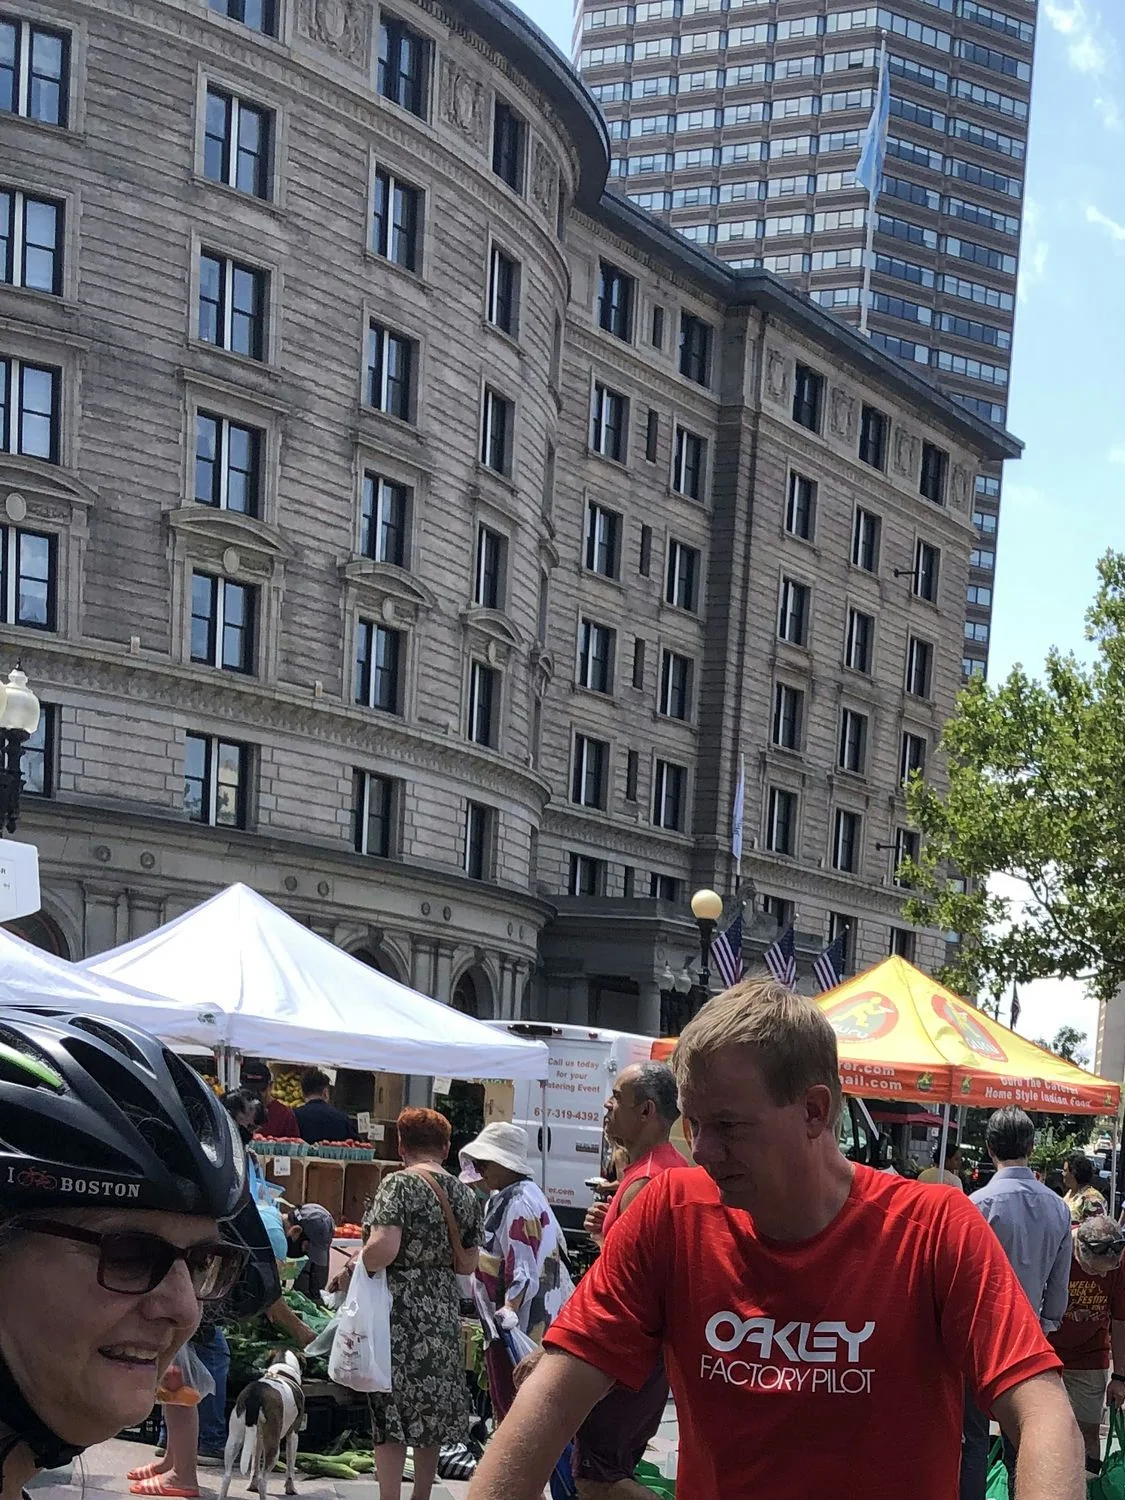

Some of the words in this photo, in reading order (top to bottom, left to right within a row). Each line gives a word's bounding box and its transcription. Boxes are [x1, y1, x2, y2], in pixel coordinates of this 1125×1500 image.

[547, 1057, 565, 1066] Call
[577, 1059, 600, 1070] today
[556, 1070, 569, 1079] for
[570, 1073, 588, 1081] your
[1024, 1076, 1042, 1088] The
[540, 1082, 575, 1093] atering
[578, 1083, 600, 1093] Event
[985, 1087, 1012, 1101] Home
[1014, 1088, 1039, 1104] Style
[1041, 1092, 1068, 1106] Indian
[534, 1108, 600, 1122] 67-319-4392
[7, 1166, 14, 1183] I
[60, 1176, 141, 1198] BOSTON
[1069, 1280, 1097, 1289] WELL
[704, 1310, 877, 1363] OAKLEY
[700, 1354, 811, 1392] FACTORY
[811, 1368, 877, 1394] PILOT
